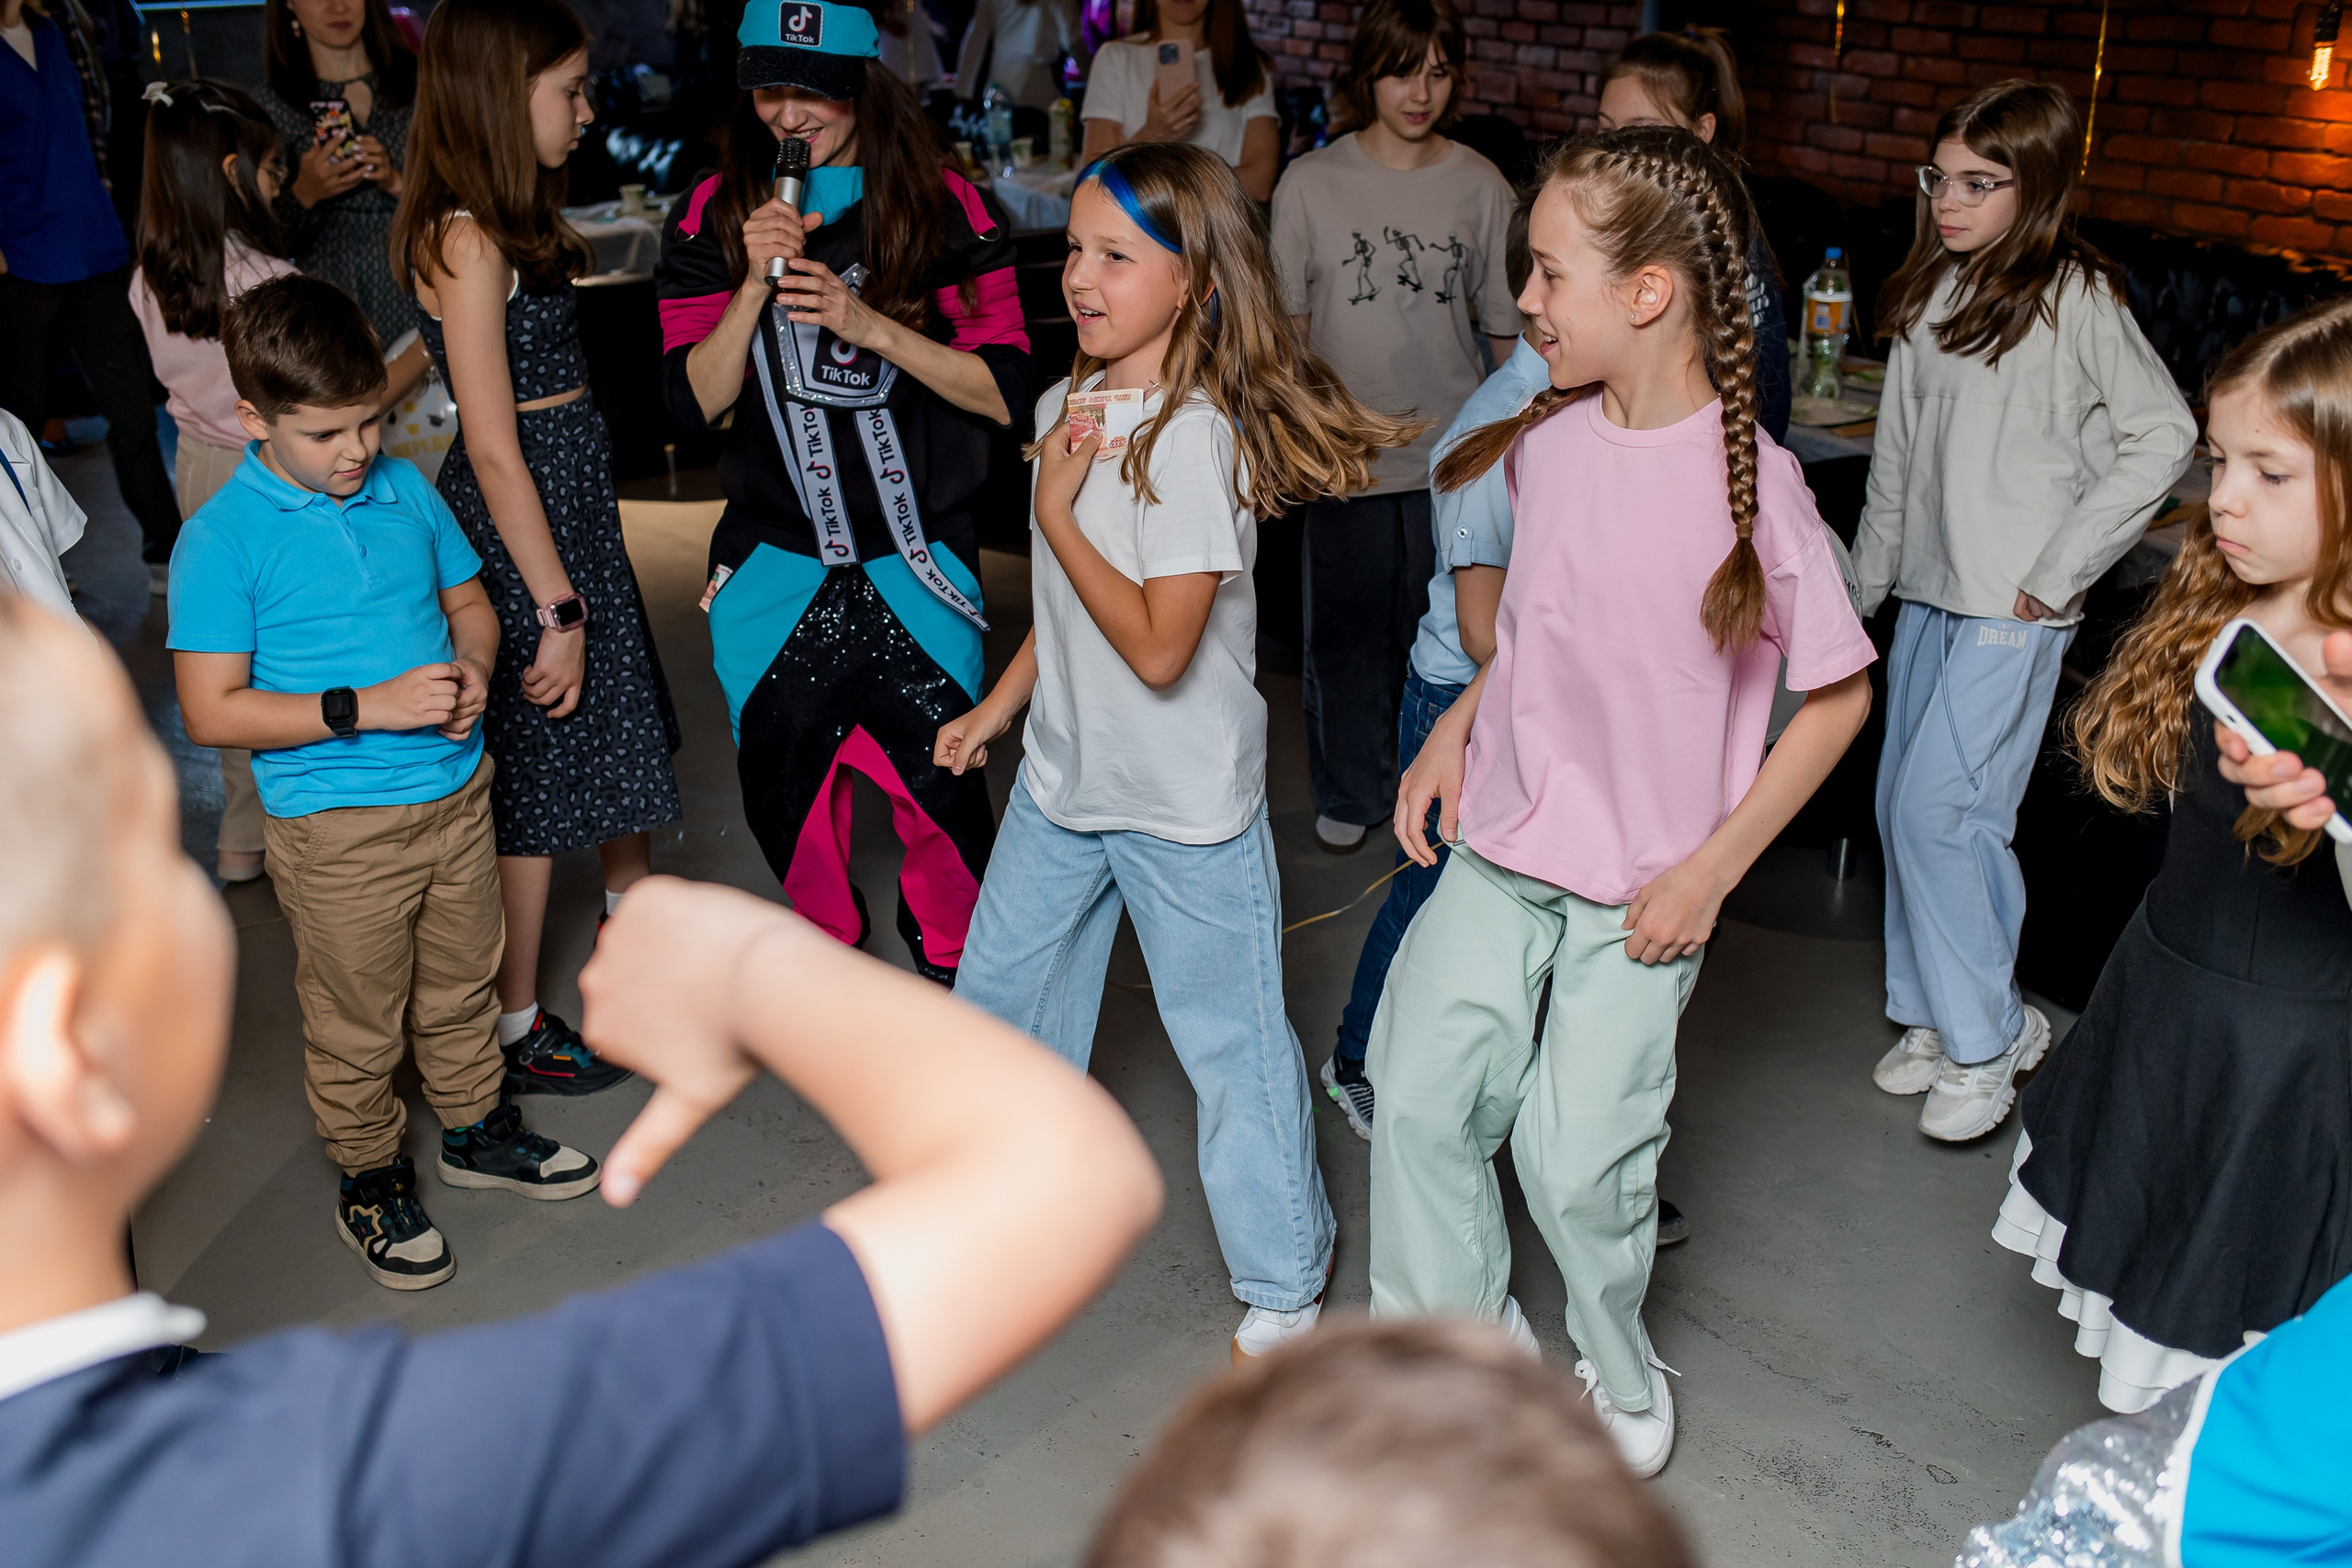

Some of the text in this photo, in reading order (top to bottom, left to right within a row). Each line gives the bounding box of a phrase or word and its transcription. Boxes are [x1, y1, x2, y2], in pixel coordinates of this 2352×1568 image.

[785, 33, 815, 43] TikTok
[821, 365, 871, 386] TikTok
[868, 409, 895, 465] TikTok
[818, 486, 841, 536] TikTok
[893, 491, 917, 547] TikTok
[925, 568, 967, 608] TikTok
[1976, 625, 2028, 650] DREAM
